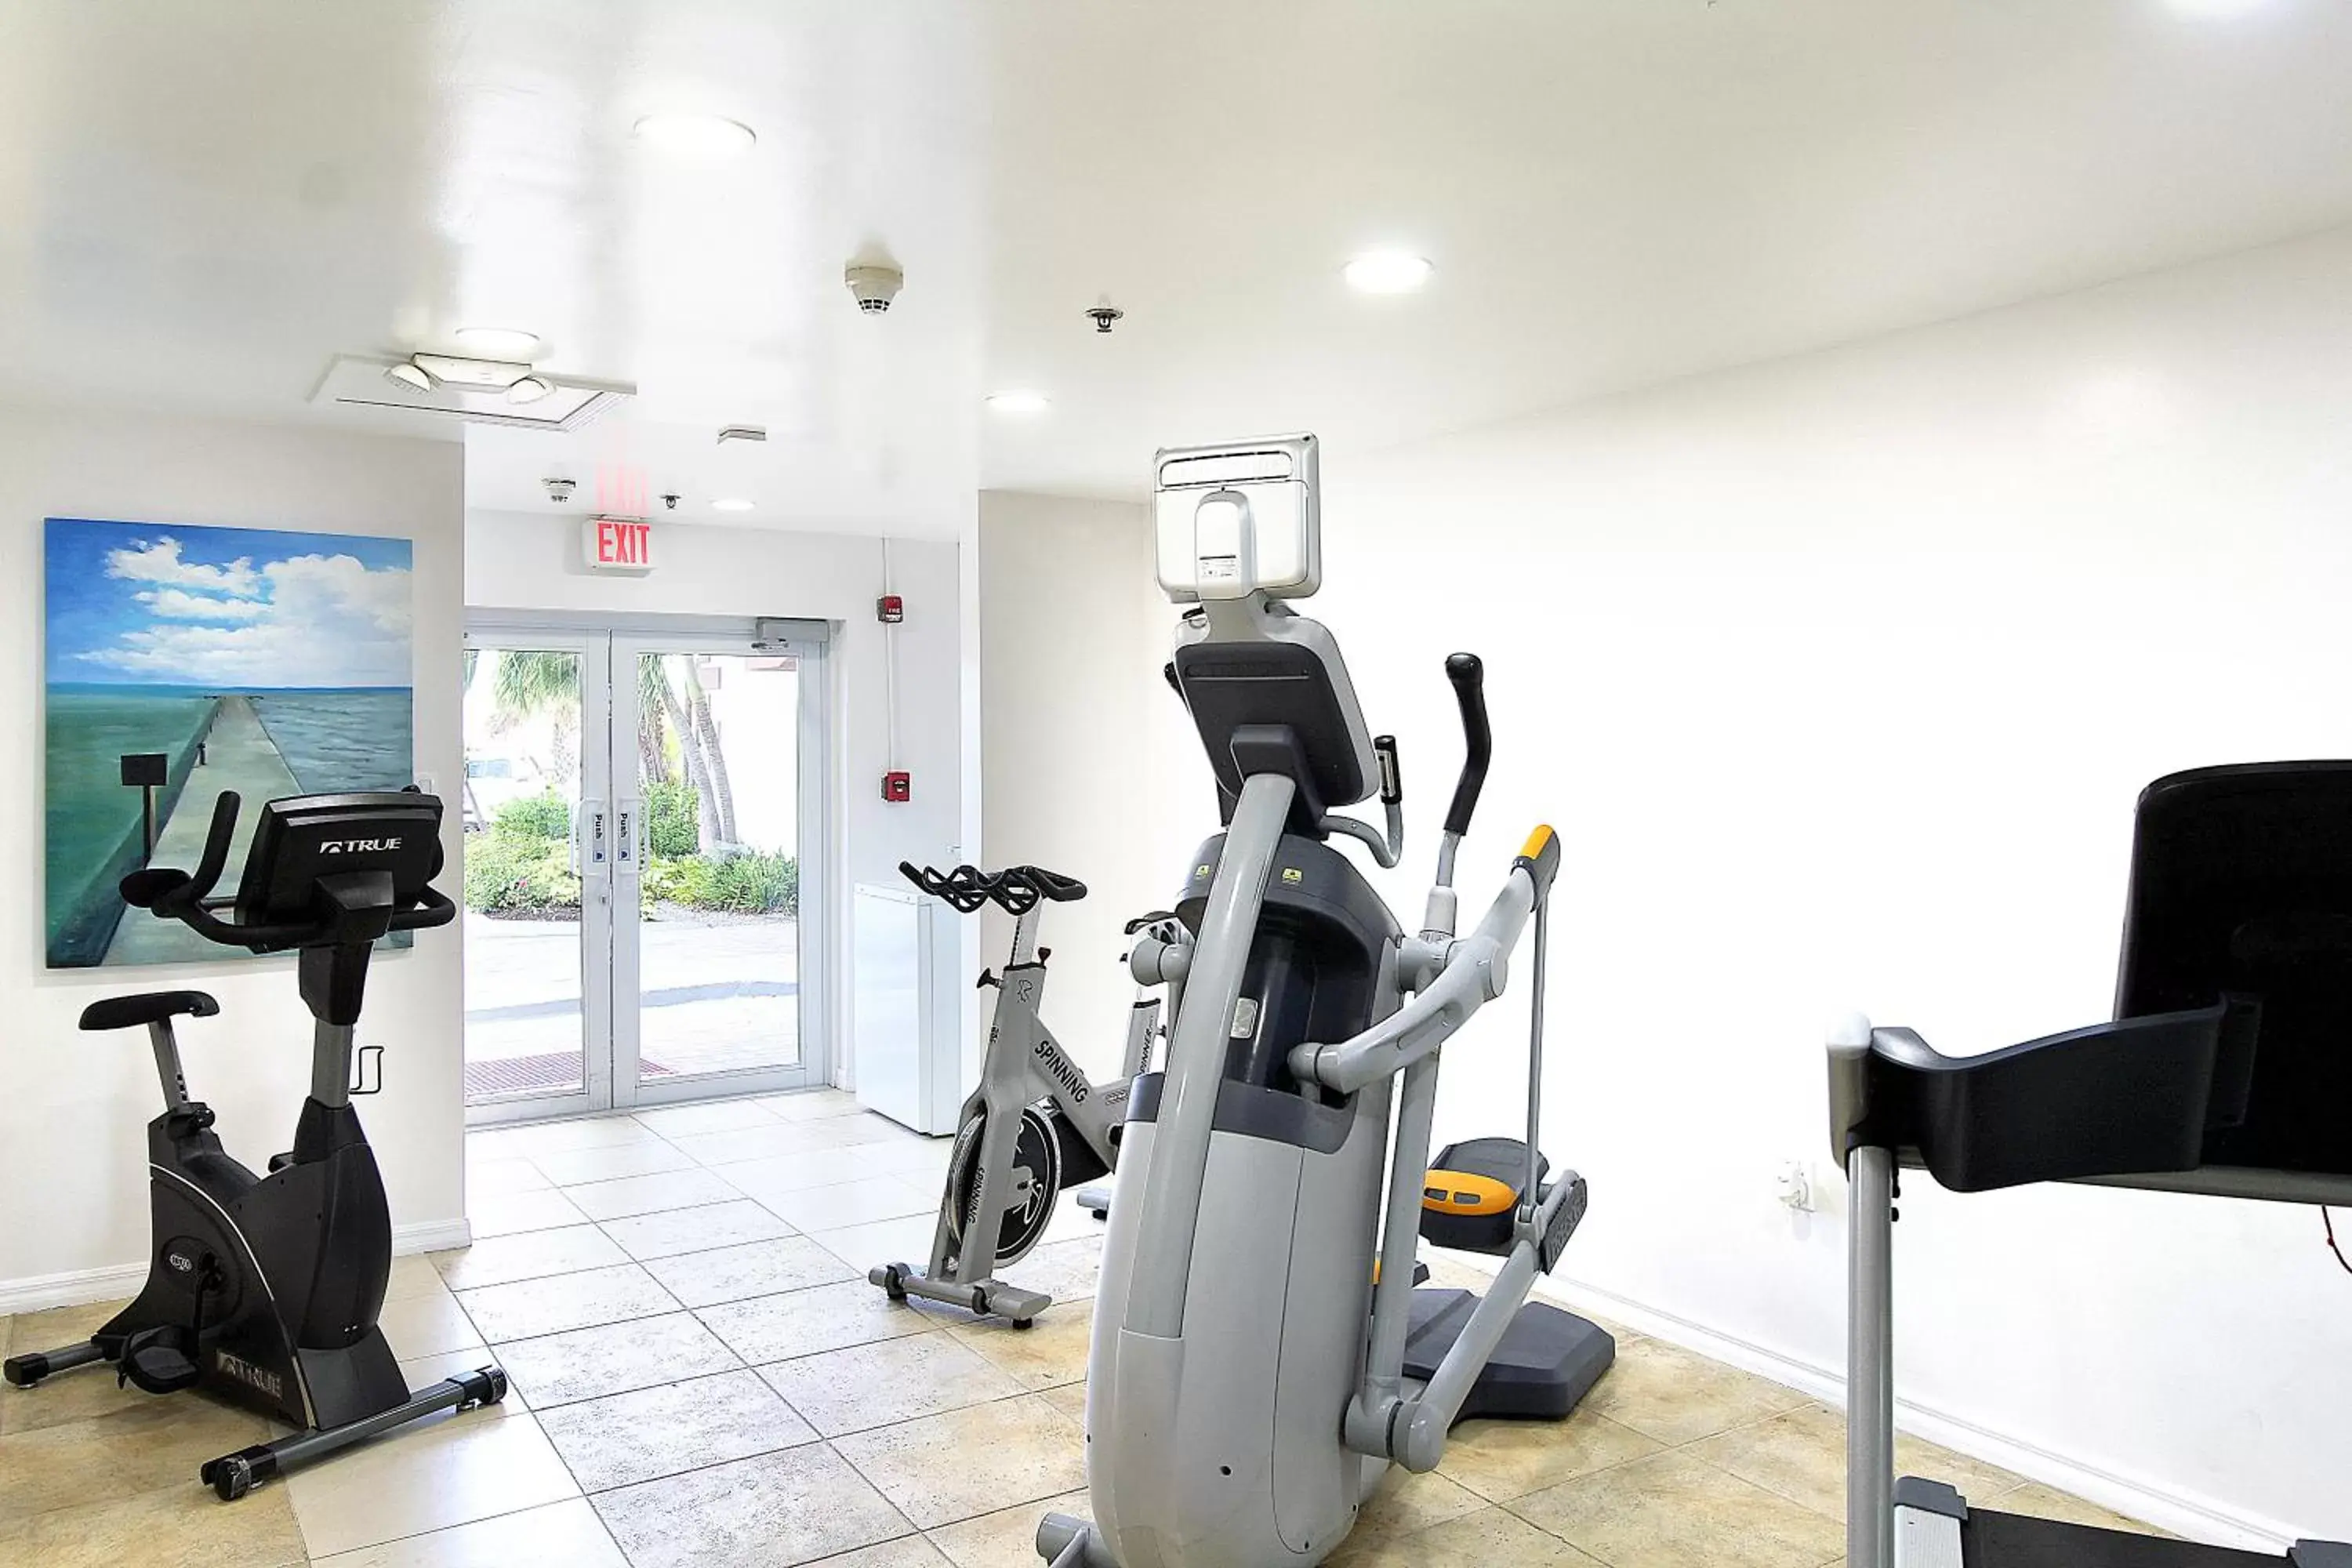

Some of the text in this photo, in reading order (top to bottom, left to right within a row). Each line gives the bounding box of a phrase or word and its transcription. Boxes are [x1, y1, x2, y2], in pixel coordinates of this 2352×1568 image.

[597, 523, 650, 564] EXIT
[344, 837, 401, 852] TRUE
[1035, 1040, 1087, 1102] SPINNING
[1139, 1028, 1152, 1073] PINNER
[967, 1167, 985, 1224] SPINNING
